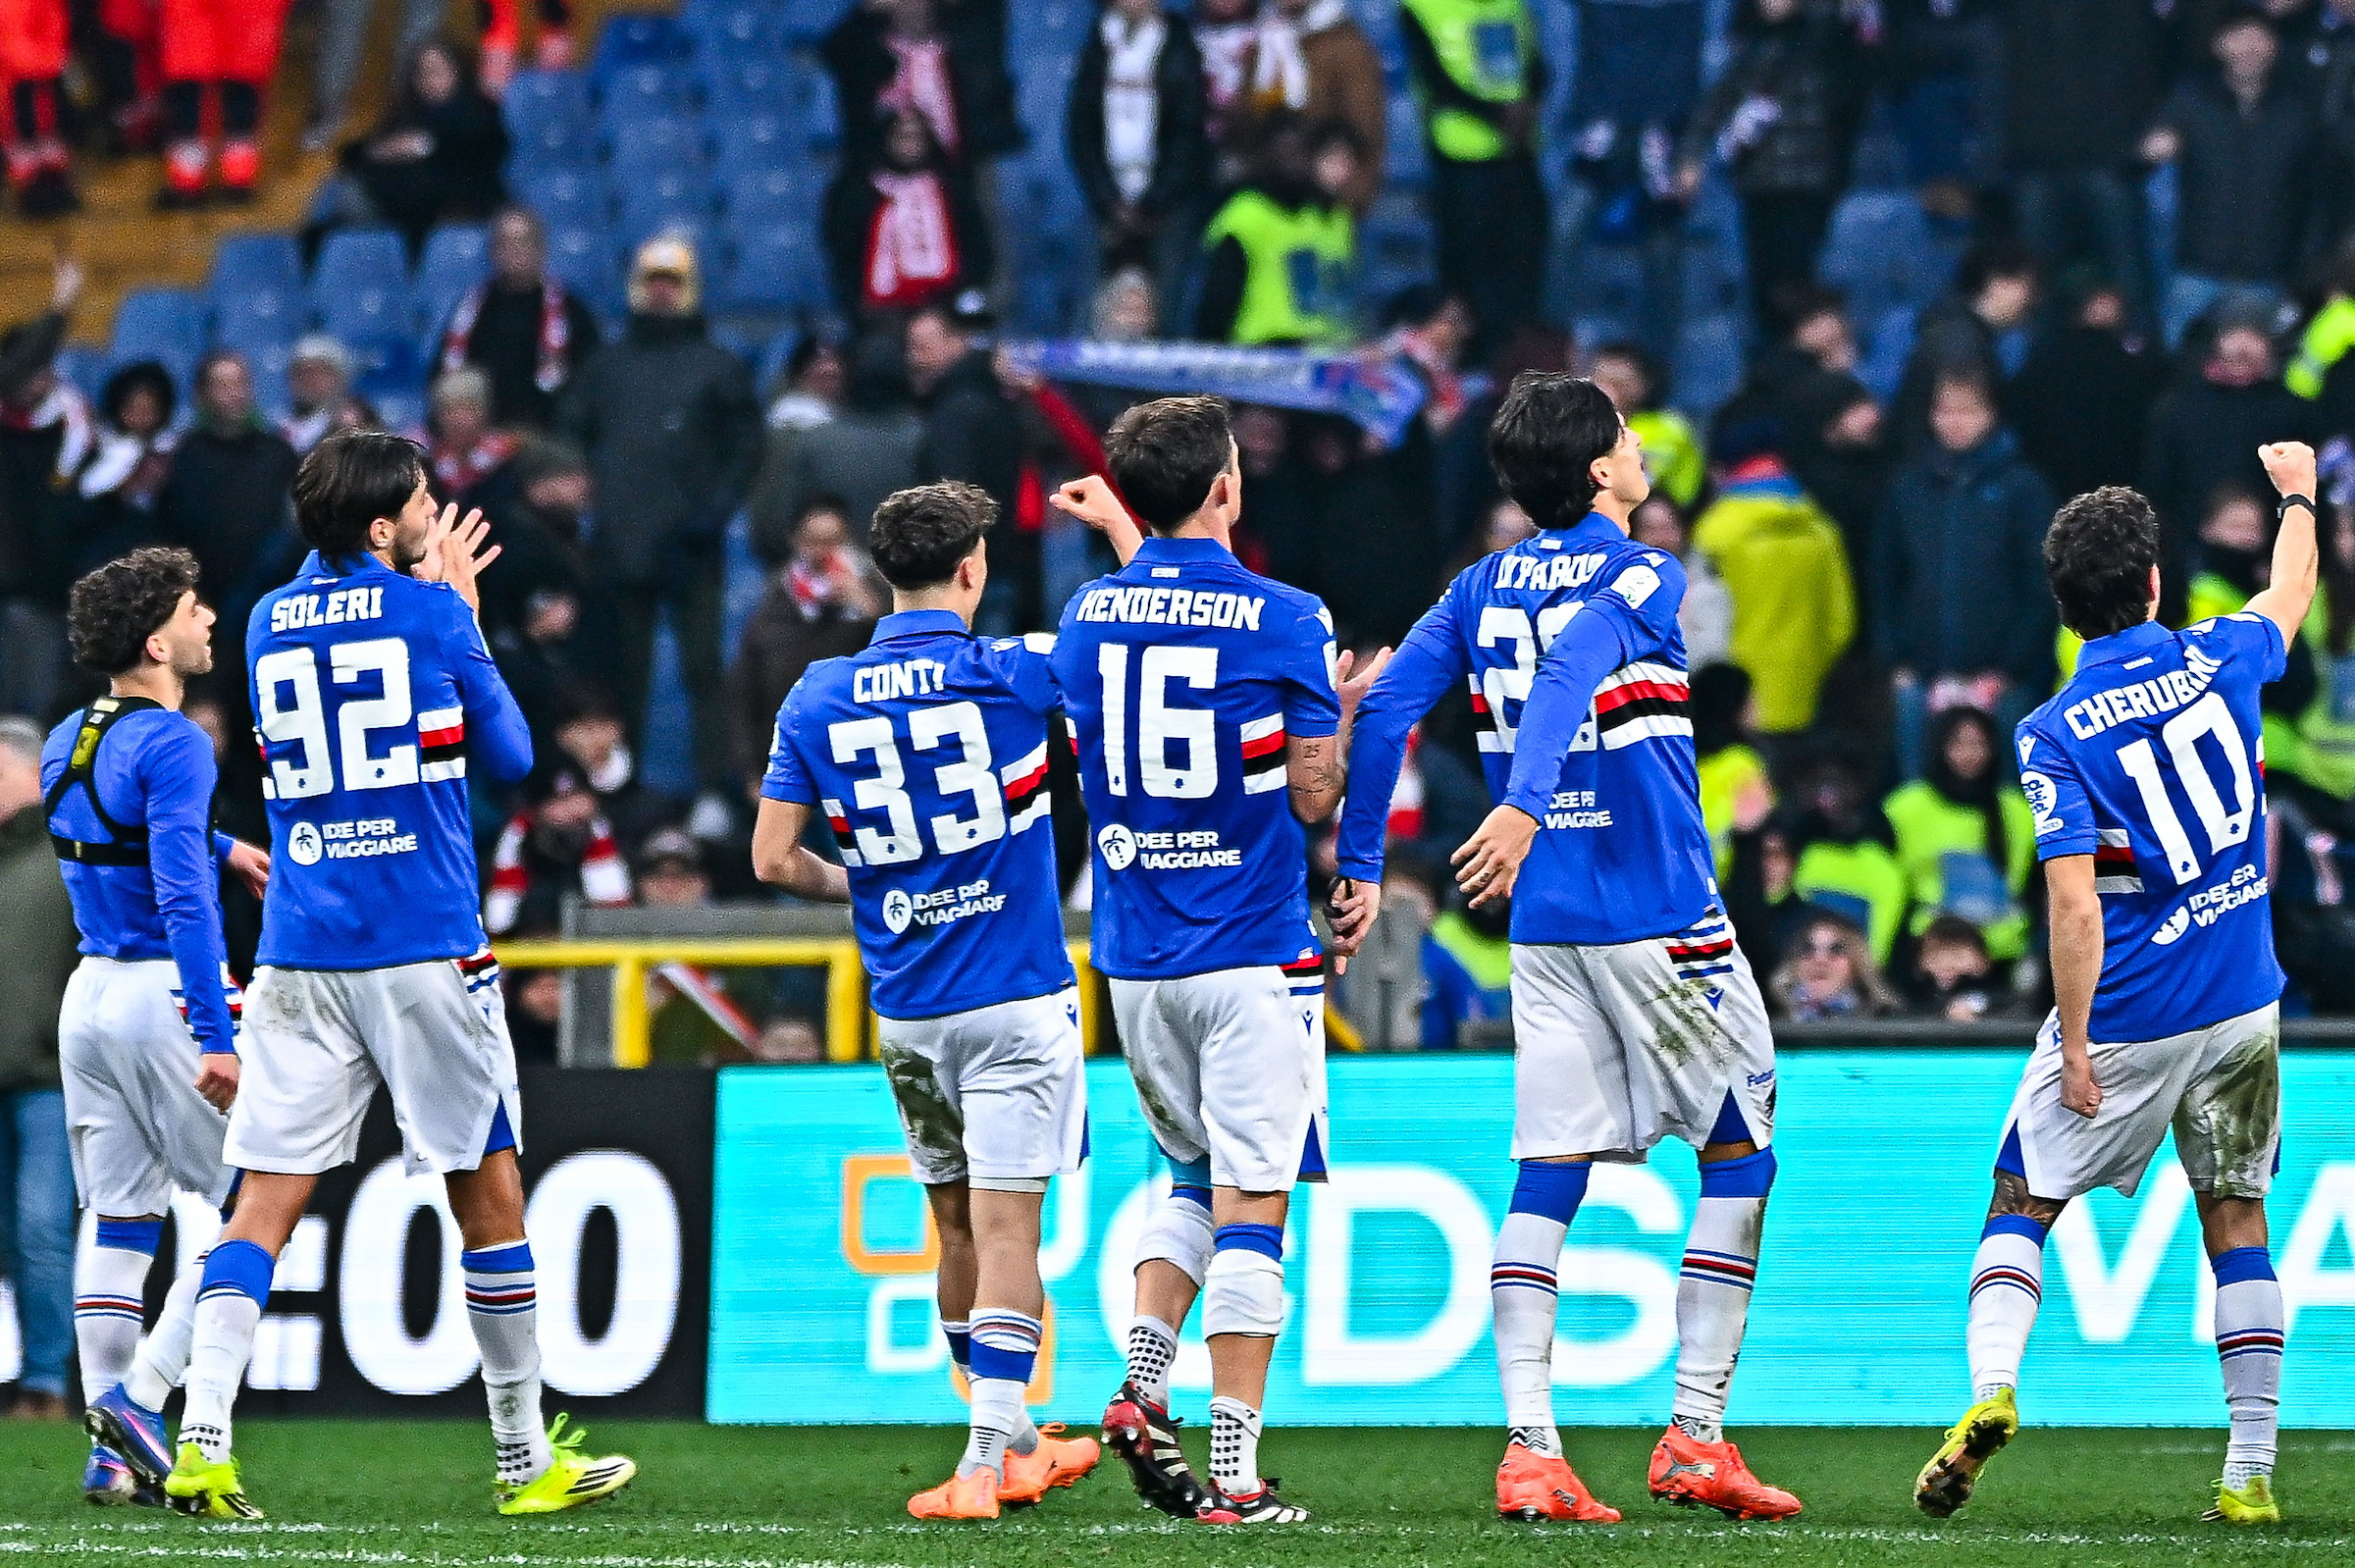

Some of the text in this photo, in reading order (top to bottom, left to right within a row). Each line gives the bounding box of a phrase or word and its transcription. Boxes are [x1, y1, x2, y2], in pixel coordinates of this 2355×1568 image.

[271, 588, 384, 633] SOLERI
[1075, 587, 1266, 632] HENDERSON
[255, 638, 419, 800] 92
[1097, 642, 1220, 799] 16
[827, 701, 1007, 866] 33
[2116, 691, 2255, 885] 10
[356, 818, 397, 837] PER
[1177, 830, 1220, 849] PER
[1140, 849, 1243, 870] IAGGIARE
[2230, 863, 2258, 887] ER
